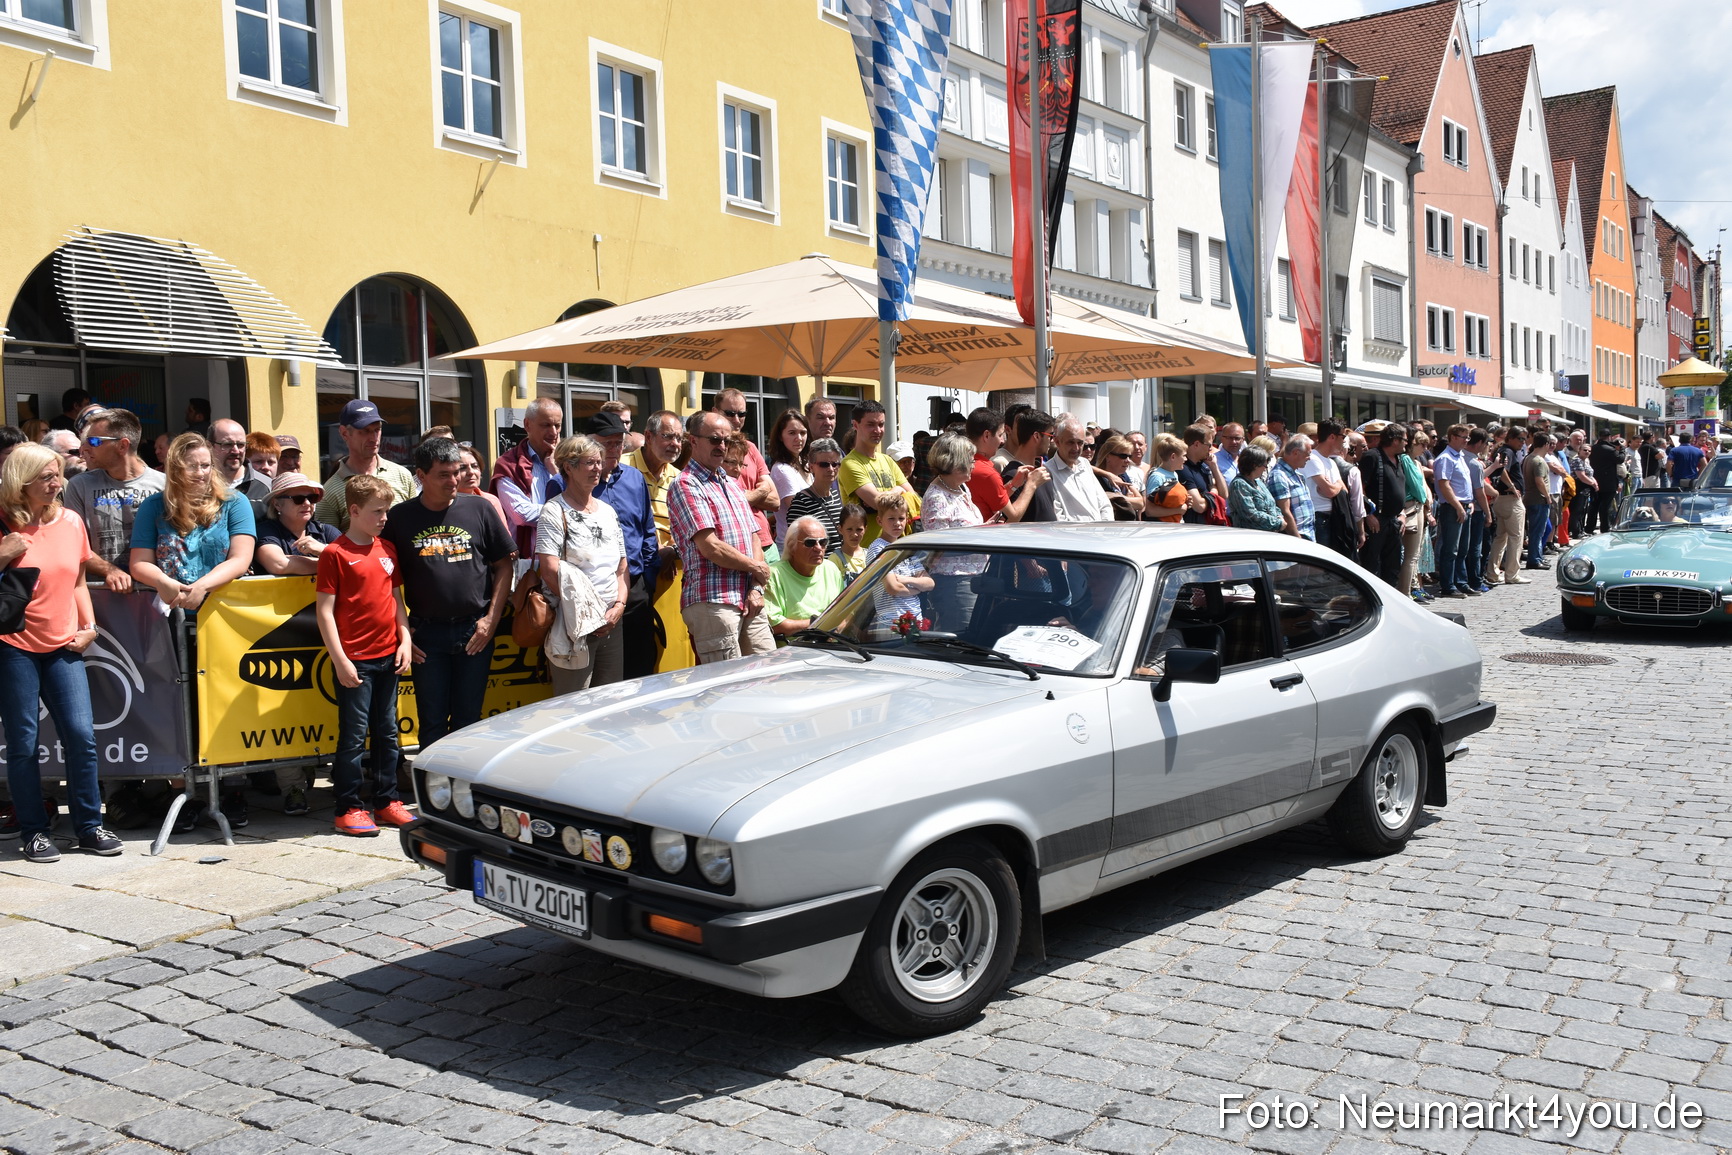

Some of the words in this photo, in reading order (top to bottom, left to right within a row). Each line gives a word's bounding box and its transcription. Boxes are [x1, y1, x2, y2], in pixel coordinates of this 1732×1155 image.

[412, 526, 446, 544] AMAZON
[448, 525, 472, 540] RIVER
[1047, 633, 1080, 647] 290
[484, 866, 496, 897] N
[506, 874, 529, 907] TV
[534, 883, 585, 926] 200H
